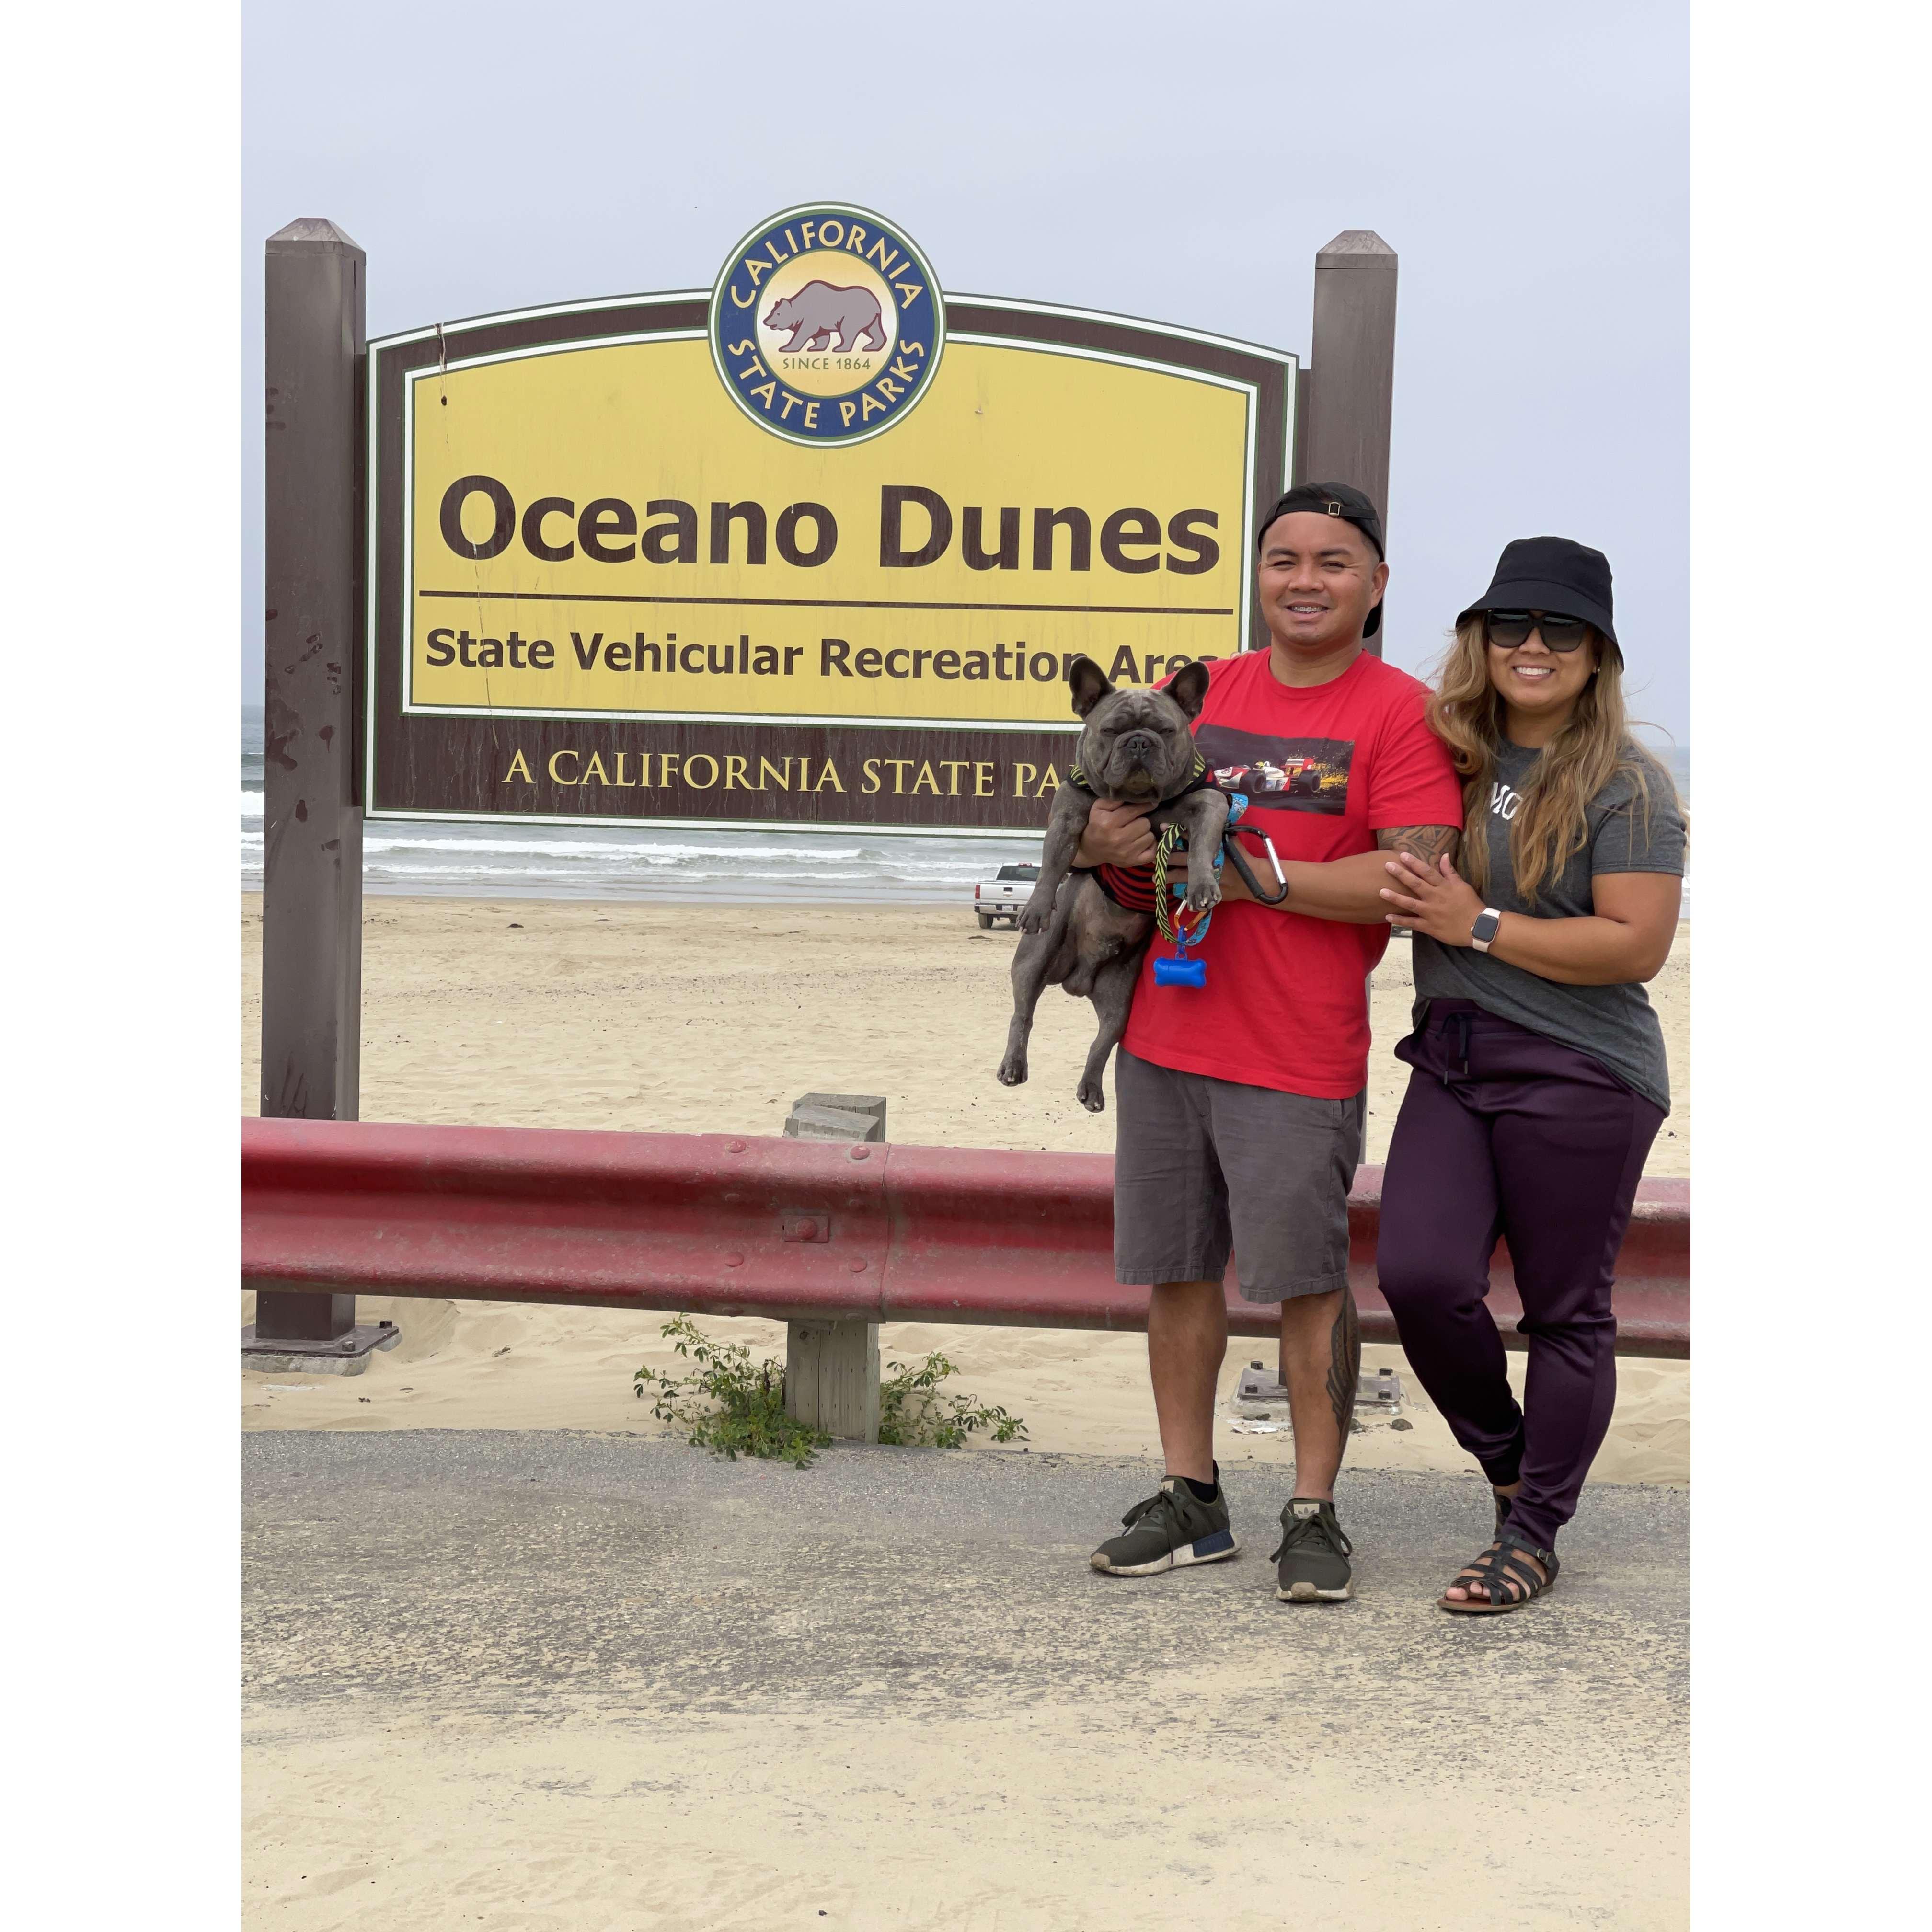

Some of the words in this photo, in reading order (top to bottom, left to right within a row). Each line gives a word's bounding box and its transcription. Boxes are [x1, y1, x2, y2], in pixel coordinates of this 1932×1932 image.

[731, 220, 923, 309] CALIFORNIA
[728, 339, 820, 429] STATE
[840, 340, 924, 427] PARKS
[782, 357, 829, 370] SINCE
[836, 357, 871, 370] 1864
[439, 475, 838, 567] Oceano
[879, 485, 1220, 575] Dunes
[426, 628, 555, 670] State
[570, 632, 804, 675] Vehicular
[1107, 645, 1219, 683] Are
[501, 748, 536, 783] A
[548, 750, 848, 793] CALIFORNIA
[862, 759, 994, 797] STATE
[1012, 763, 1074, 798] PA
